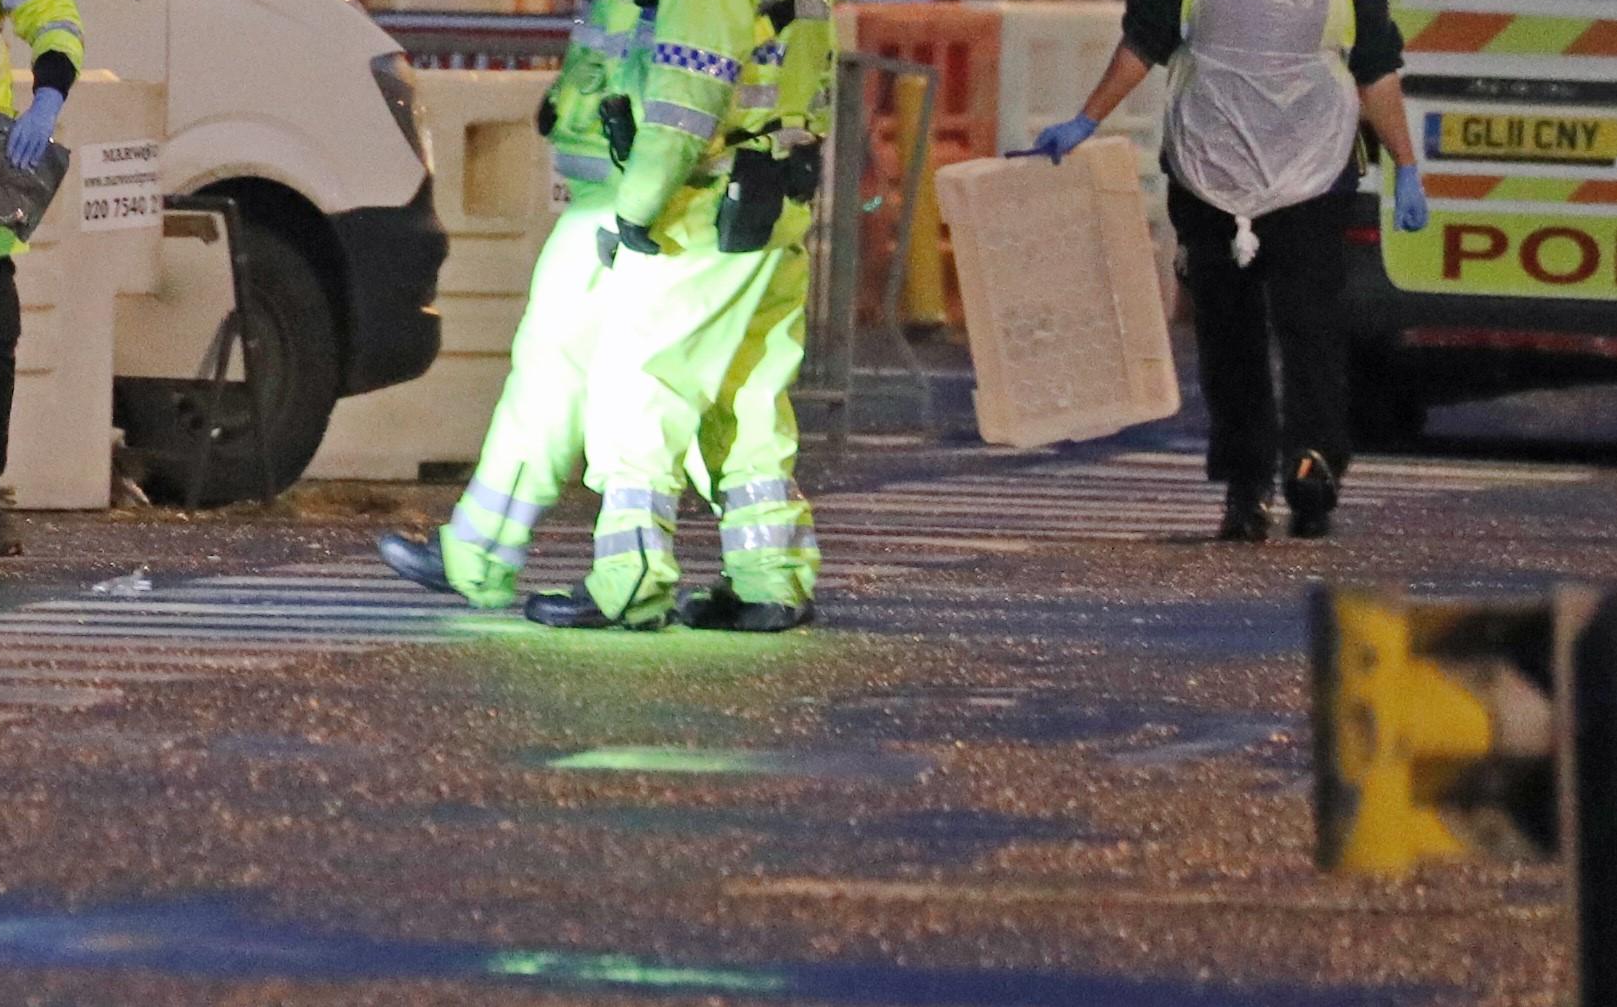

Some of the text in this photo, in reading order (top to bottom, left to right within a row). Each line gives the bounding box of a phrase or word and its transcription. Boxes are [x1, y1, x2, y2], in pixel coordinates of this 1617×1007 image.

[1535, 120, 1600, 151] CNY
[84, 198, 109, 221] 020
[114, 195, 147, 218] 7540
[1442, 223, 1617, 287] PO
